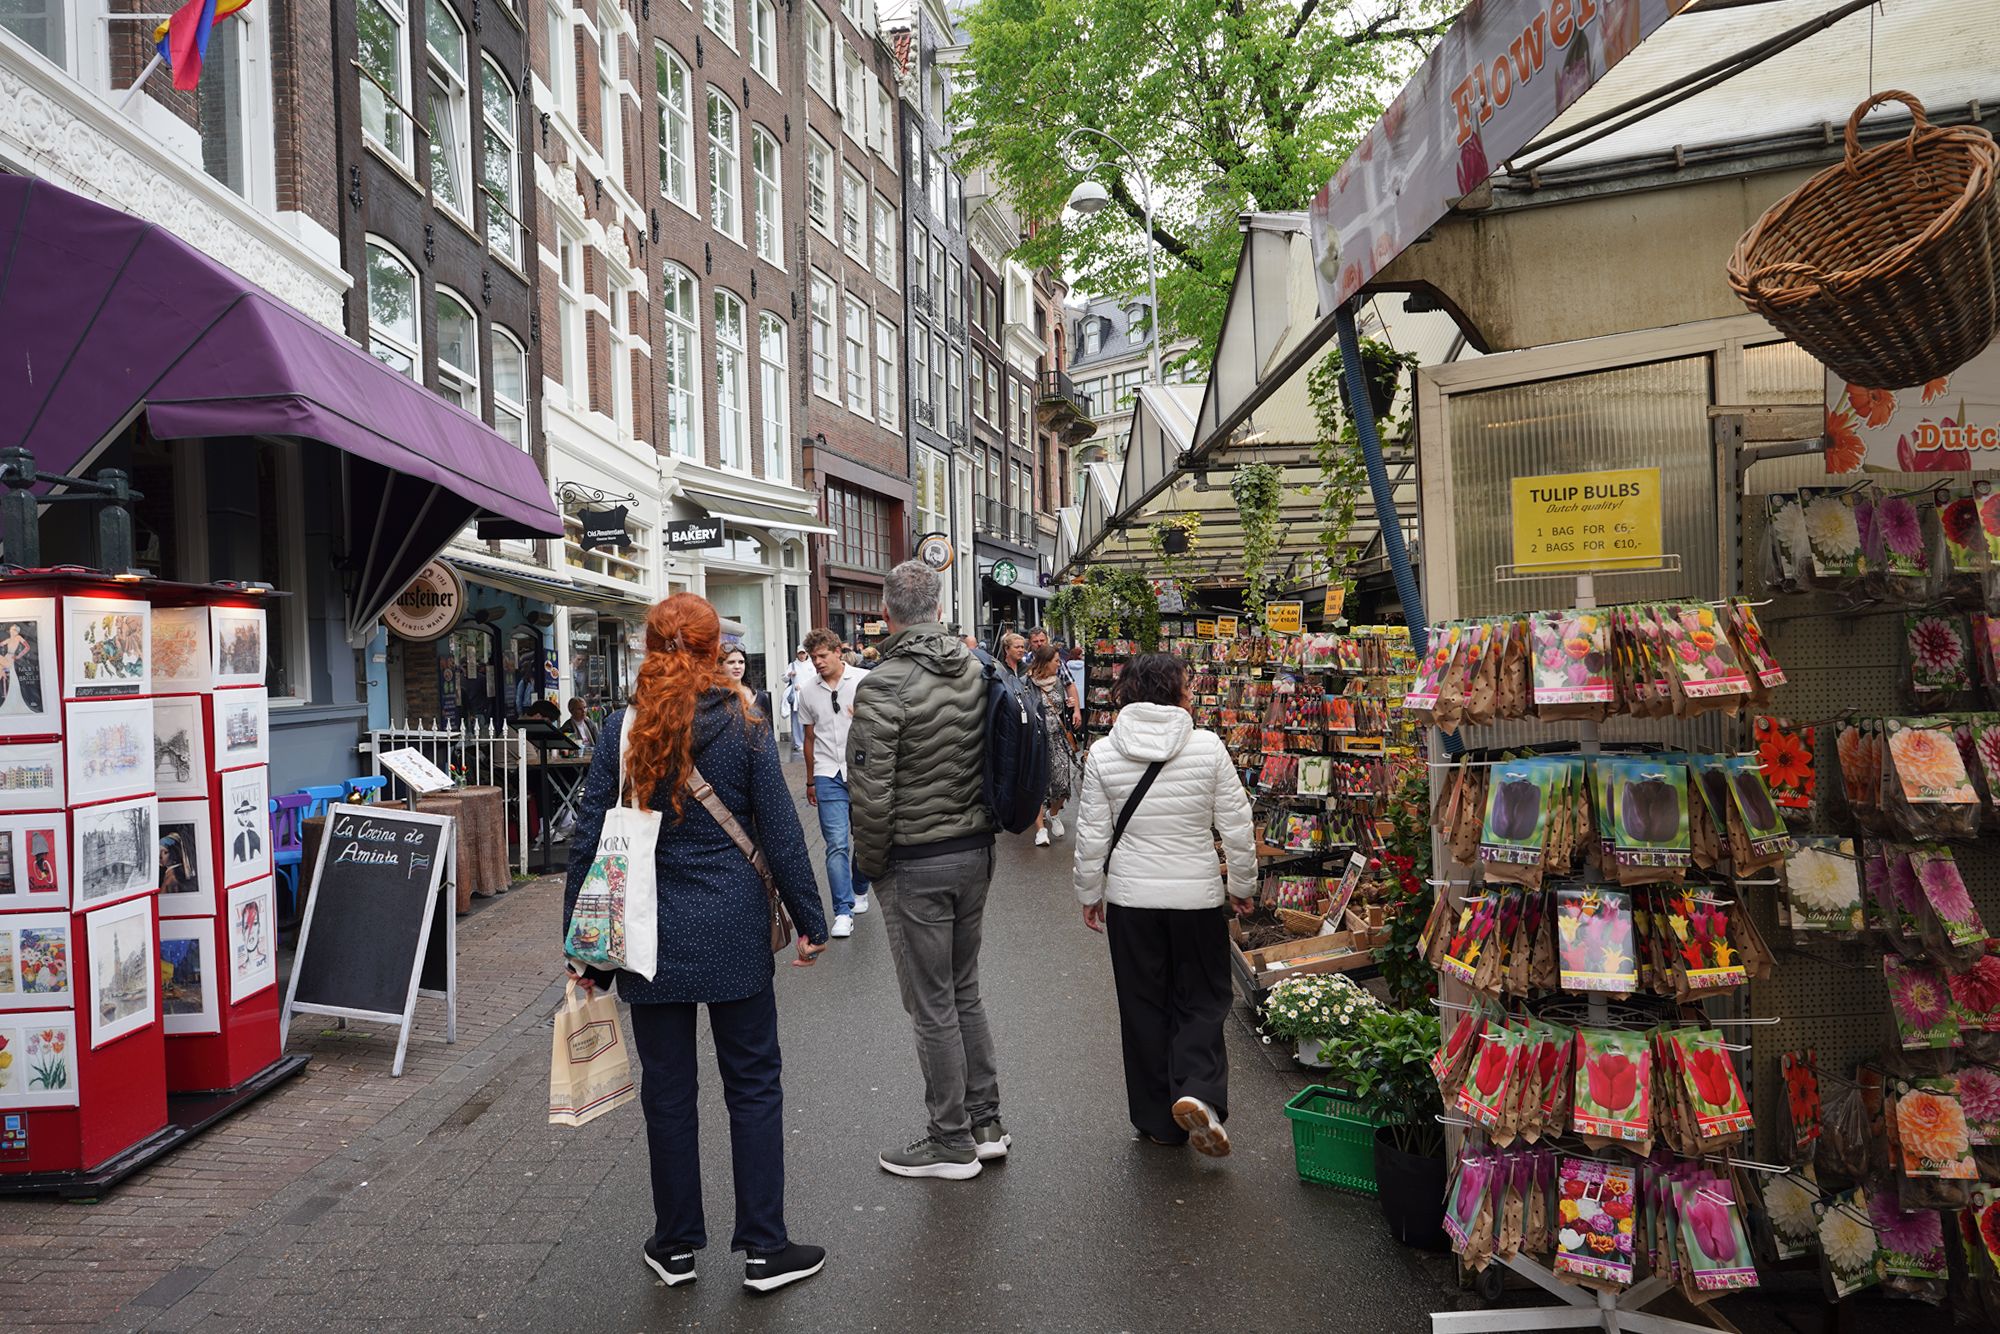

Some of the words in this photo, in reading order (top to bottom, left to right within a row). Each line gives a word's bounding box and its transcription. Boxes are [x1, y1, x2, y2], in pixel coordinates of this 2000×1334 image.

[1917, 423, 2000, 449] Dutc
[1530, 487, 1579, 503] TULIP
[1584, 482, 1640, 500] BULBS
[1546, 503, 1578, 514] Dutch
[1581, 500, 1625, 513] quality!
[671, 528, 717, 542] BAKERY
[1537, 528, 1543, 537] 1
[1552, 526, 1574, 536] BAG
[1583, 525, 1605, 534] FOR
[1531, 544, 1537, 553] 2
[1546, 542, 1575, 552] BAGS
[1583, 541, 1605, 550] FOR
[1614, 538, 1642, 550] €10,-
[1825, 559, 1854, 568] Dahlia
[401, 622, 425, 631] EINZIG
[1769, 787, 1802, 799] Dahlia
[334, 816, 354, 836] La
[358, 820, 396, 841] Cocina
[404, 828, 424, 844] de
[336, 841, 399, 864] Aminta
[1808, 911, 1846, 922] Dahlia
[1913, 1029, 1946, 1040] Dahlia
[1920, 1159, 1959, 1170] Dahlia
